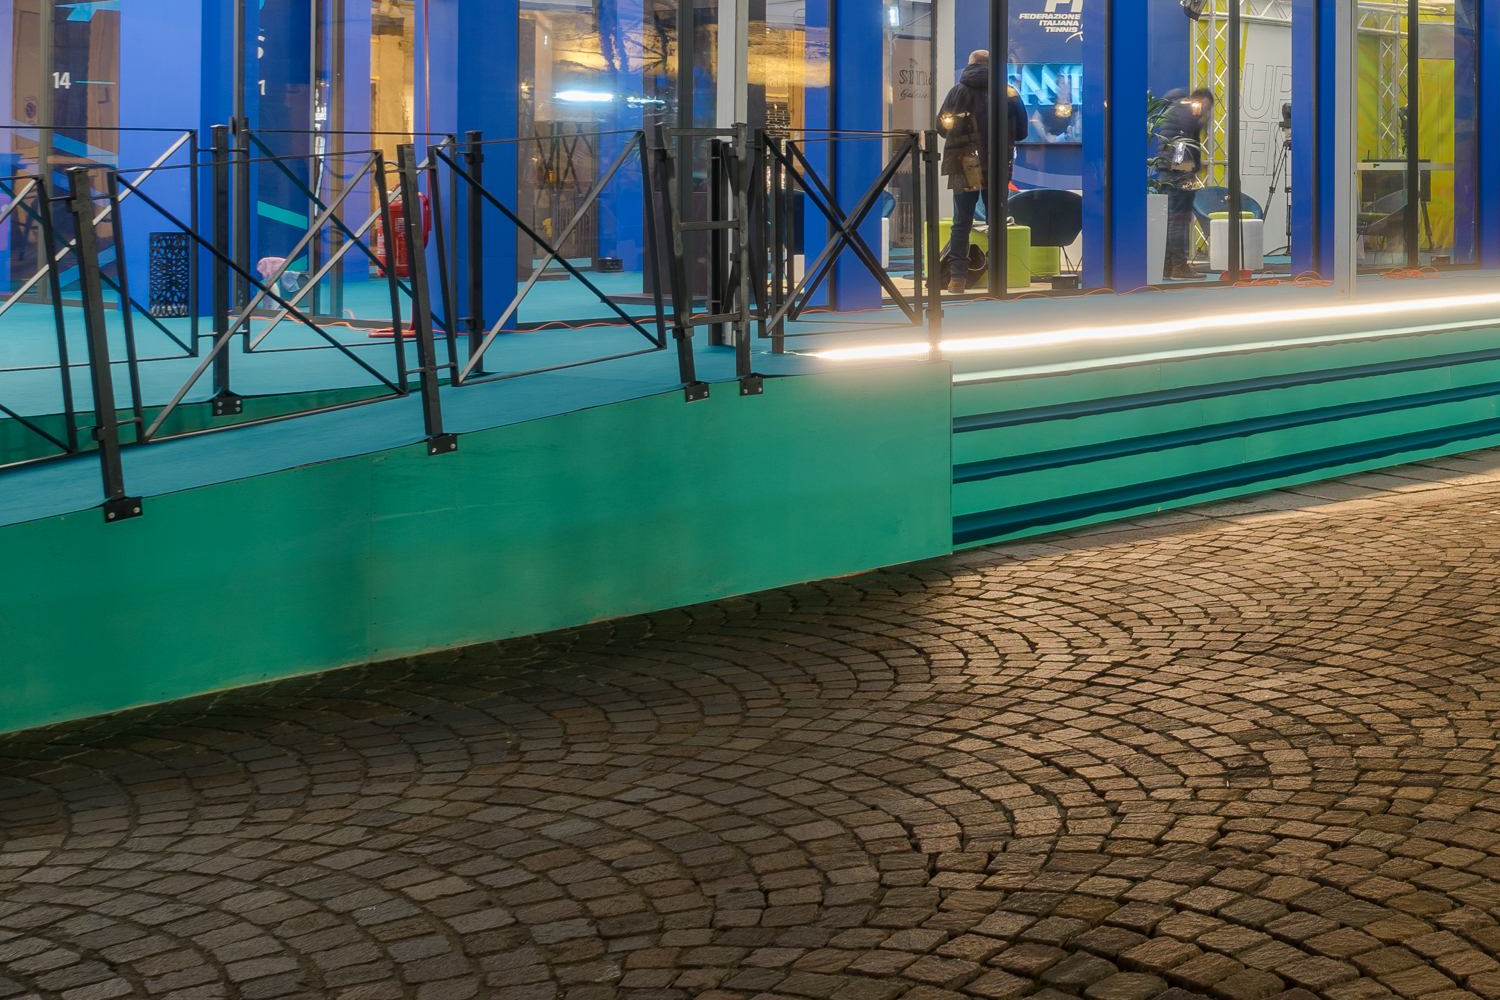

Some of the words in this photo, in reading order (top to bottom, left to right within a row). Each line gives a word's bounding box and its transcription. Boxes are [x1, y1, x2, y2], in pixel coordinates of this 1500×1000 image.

[1018, 12, 1081, 20] FEDERAZIONE
[1038, 19, 1080, 27] ITALIANA
[52, 71, 72, 89] 14
